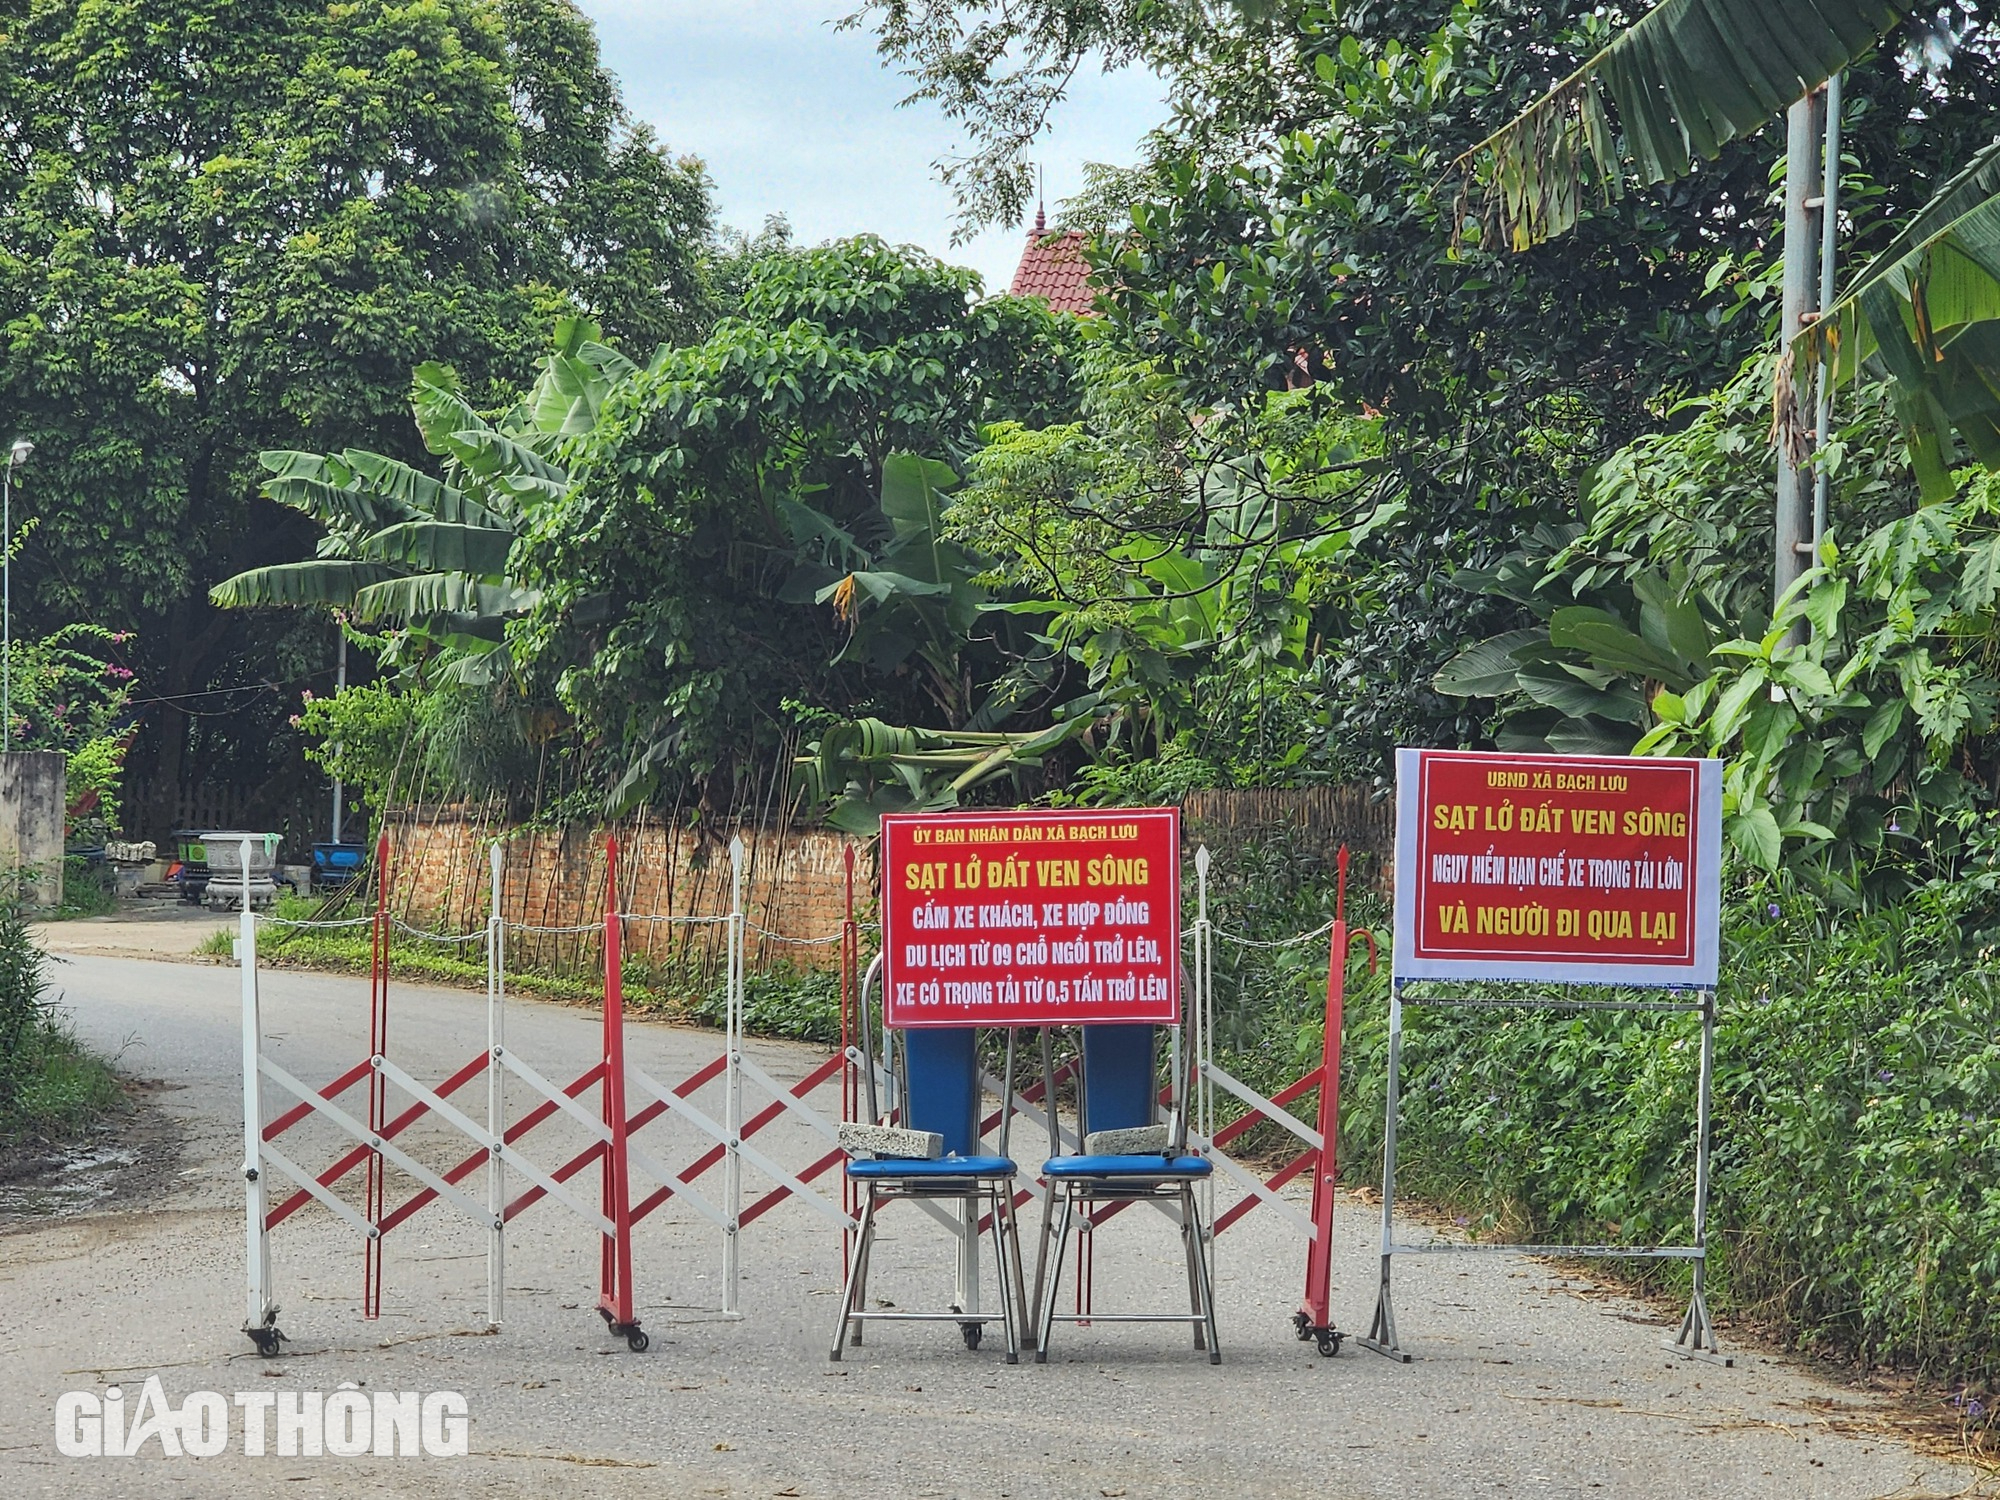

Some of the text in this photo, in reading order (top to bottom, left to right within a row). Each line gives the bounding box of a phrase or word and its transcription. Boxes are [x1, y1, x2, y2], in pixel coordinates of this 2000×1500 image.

[1488, 771, 1627, 792] UBND XÃ BẠCH LƯU
[914, 824, 1138, 845] ỦY BAN NHÂN DÂN XÃ BẠCH LƯU
[1434, 799, 1685, 837] SẠT LỞ ĐẤT VEN SÔNG
[906, 852, 1148, 895] SẠT LỞ ĐẤT VEN SÔNG
[1433, 844, 1682, 894] NGUY HIỂM HẠN CHẾ XE TRỌNG TẢI LỚN
[913, 899, 949, 929] CẤM
[954, 906, 974, 928] XE
[979, 900, 1038, 929] KHÁCH,
[1042, 904, 1063, 926] XE
[1068, 901, 1100, 930] HỢP
[1439, 900, 1675, 945] VÀ NGƯỜI ĐI QUA LẠI
[906, 945, 927, 967] DU
[931, 944, 965, 971] LỊCH
[969, 939, 990, 966] TỪ
[993, 944, 1010, 966] 09
[1016, 934, 1047, 965] CHỖ
[1094, 933, 1123, 963] TRỞ
[1128, 936, 1161, 965] LÊN,
[896, 971, 1167, 1009] XE CÓ TRỌNG TẢI TỪ 0,5 TẤN TRỞ LÊN
